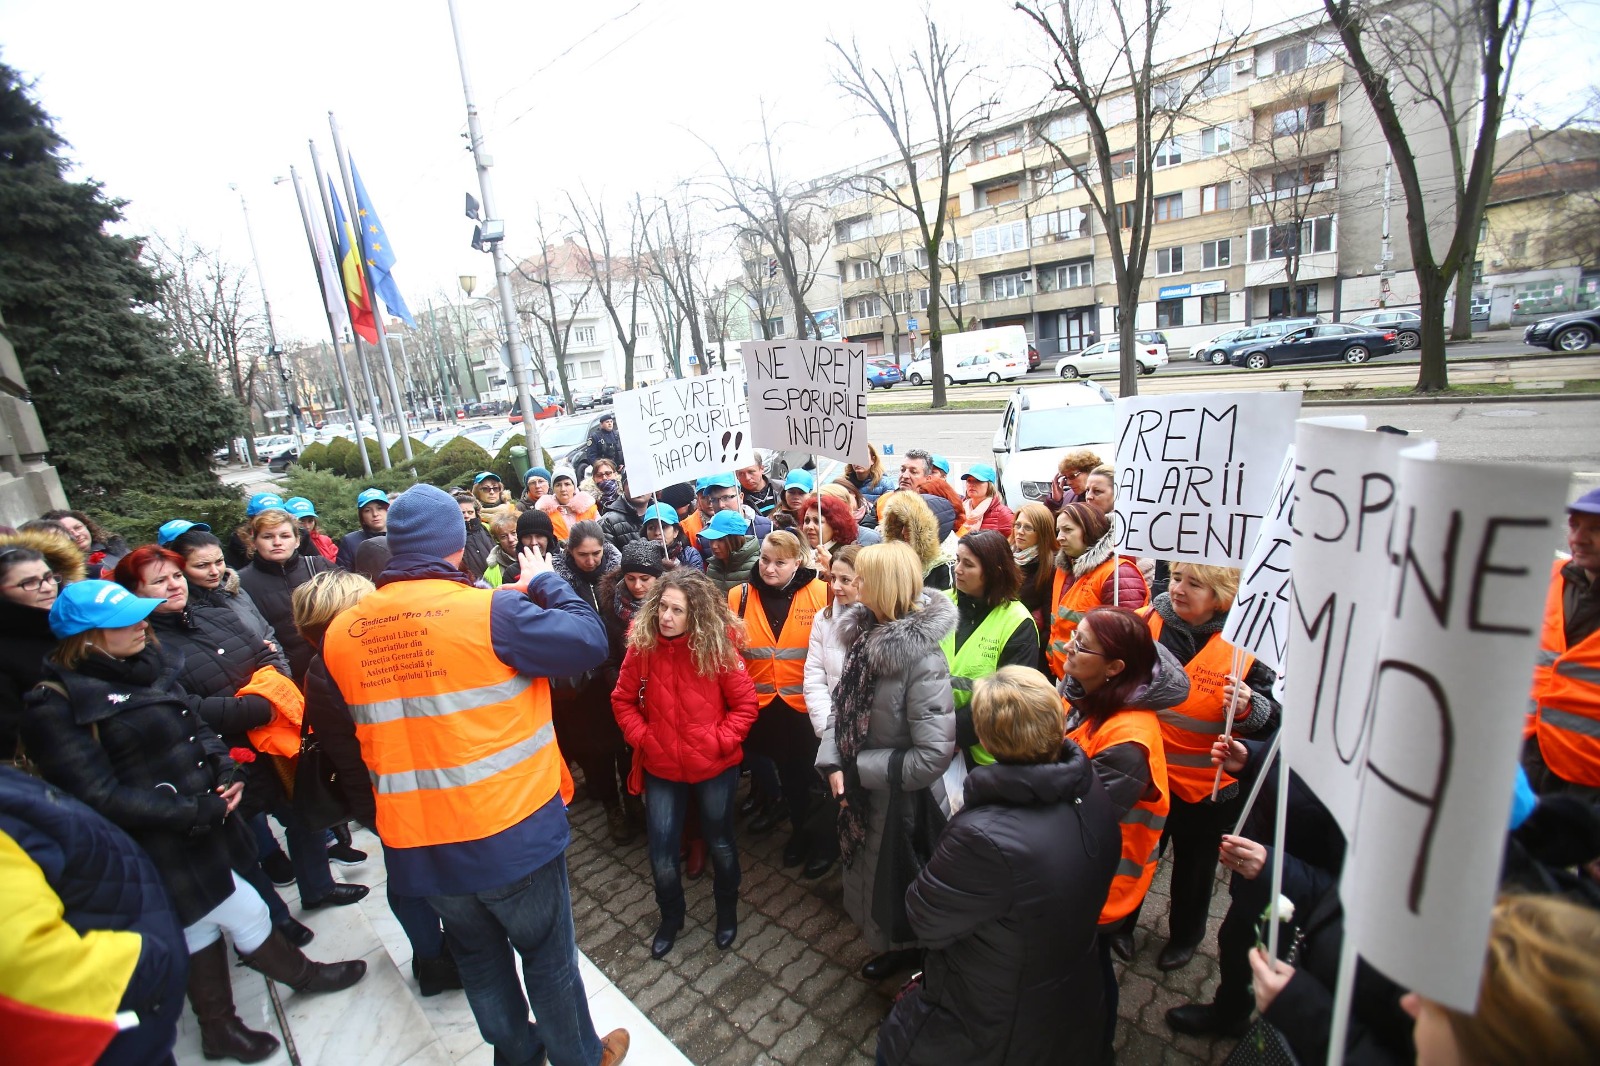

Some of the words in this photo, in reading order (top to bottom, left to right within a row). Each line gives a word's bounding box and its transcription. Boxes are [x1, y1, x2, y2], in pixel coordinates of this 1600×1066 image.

[754, 346, 790, 380] NE
[800, 345, 865, 391] VREM
[638, 390, 664, 421] NE
[673, 375, 737, 411] VREM
[1395, 506, 1550, 636] NE
[361, 614, 400, 628] Sindicatul
[361, 632, 397, 646] Sindicatul
[398, 630, 419, 639] Liber
[420, 627, 428, 636] al
[410, 639, 423, 648] din
[425, 648, 435, 656] de
[393, 671, 423, 682] Copilului
